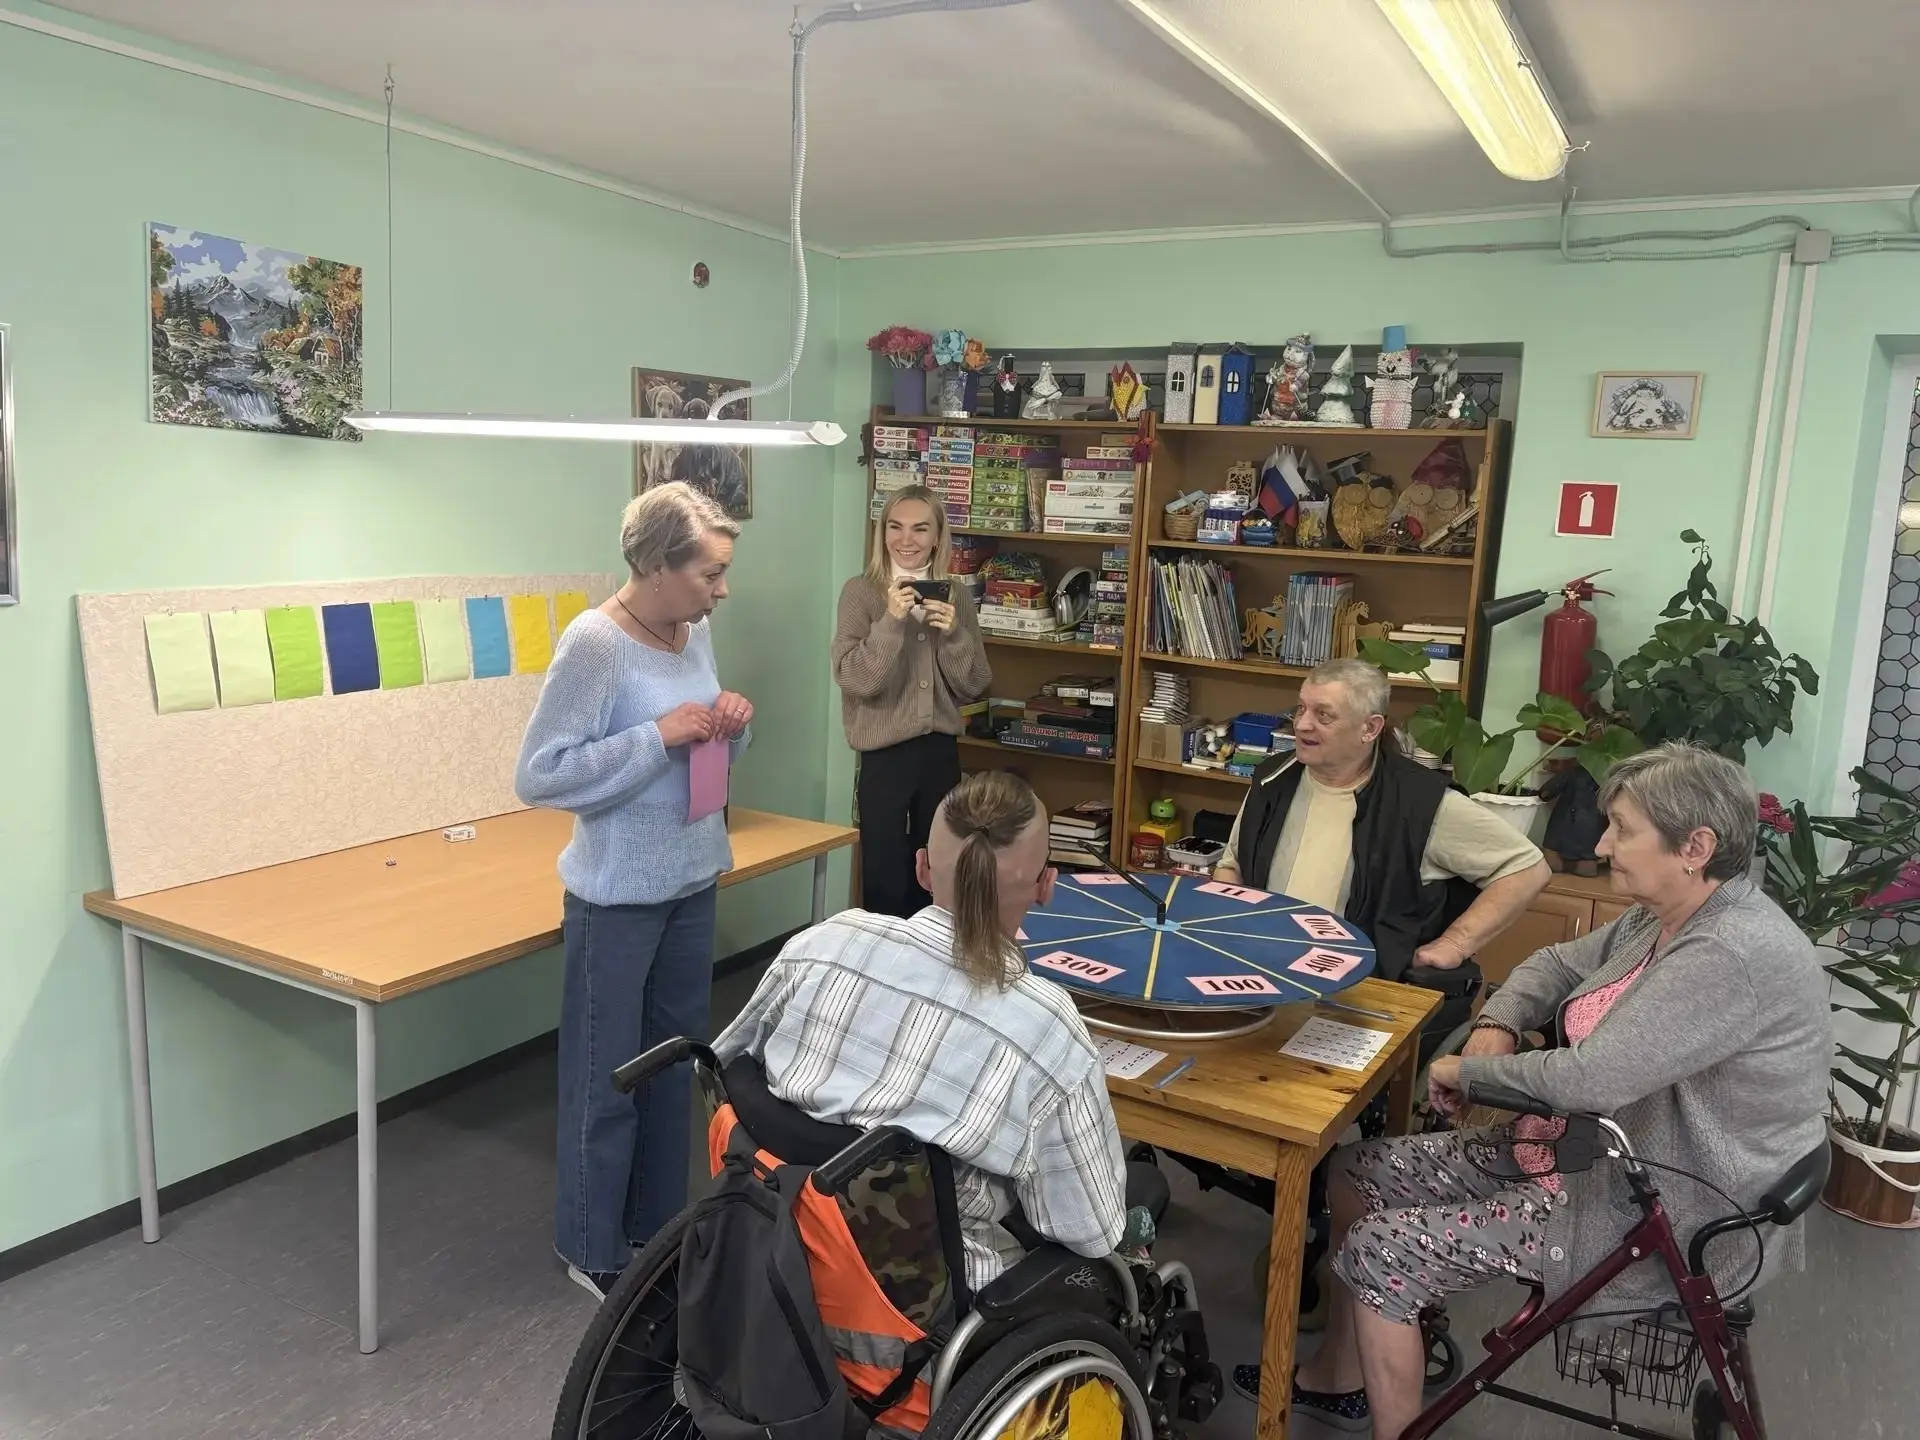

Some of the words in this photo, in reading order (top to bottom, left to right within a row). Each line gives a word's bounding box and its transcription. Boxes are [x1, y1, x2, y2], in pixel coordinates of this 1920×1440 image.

[1304, 918, 1346, 937] 200
[1047, 955, 1109, 976] 300
[1305, 954, 1345, 973] 400
[1202, 978, 1266, 992] 100
